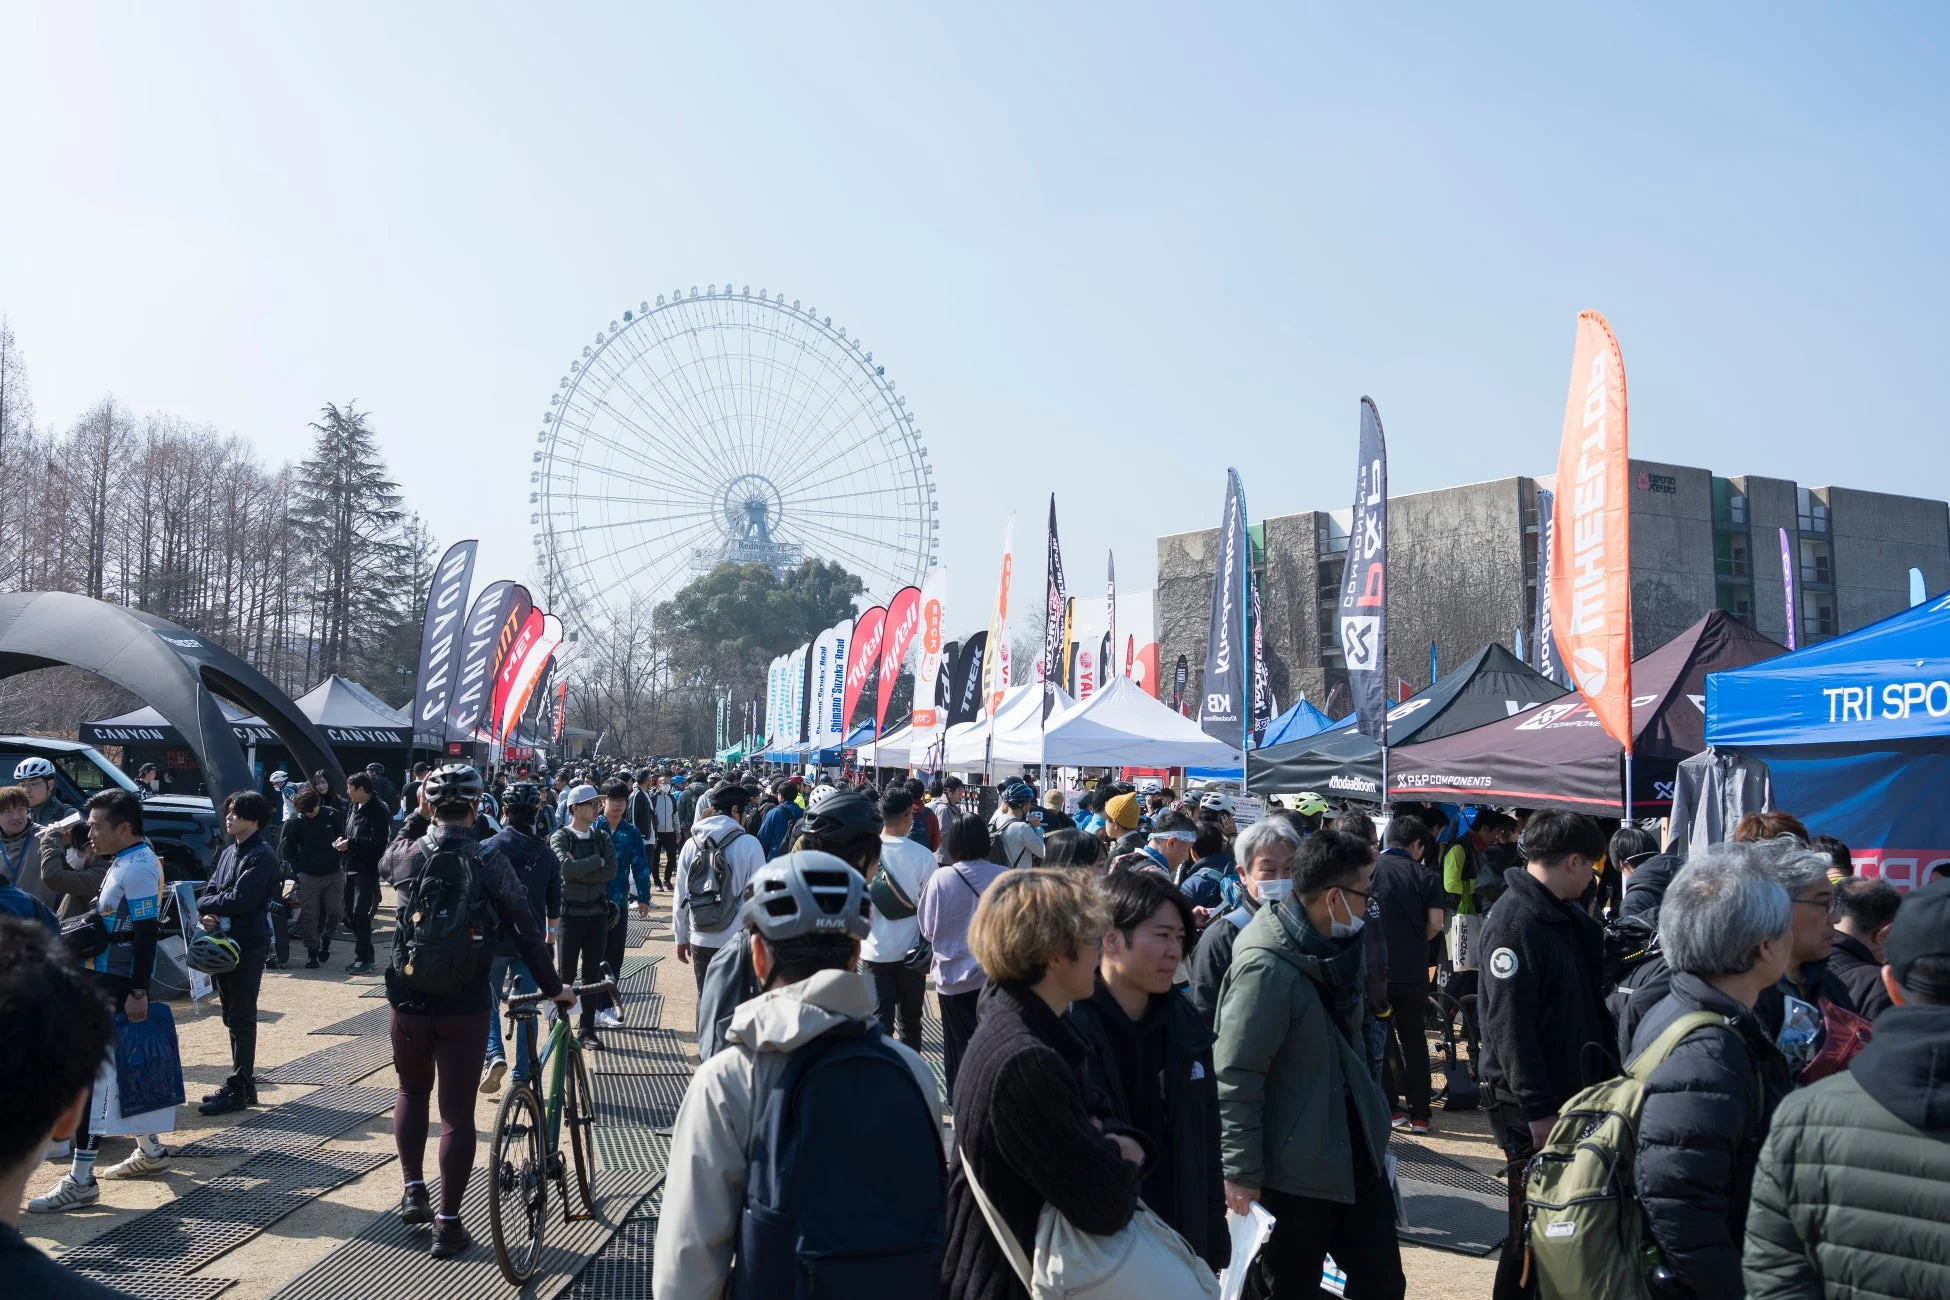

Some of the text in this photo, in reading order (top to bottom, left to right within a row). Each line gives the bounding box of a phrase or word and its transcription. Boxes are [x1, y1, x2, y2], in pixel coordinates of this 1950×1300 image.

[422, 550, 467, 721] CANYON
[503, 625, 532, 682] MET
[835, 639, 845, 660] Road
[847, 618, 884, 688] Tyrell
[880, 600, 918, 681] Tyrell
[456, 588, 504, 728] CANYON
[961, 644, 983, 713] TREK
[831, 697, 842, 733] Shimano
[1823, 685, 1873, 723] TRI
[93, 728, 165, 740] CANYON
[327, 728, 402, 743] CANYON
[1329, 775, 1377, 793] KhodaaBloom
[1407, 774, 1492, 788] P&P COMPONENTS
